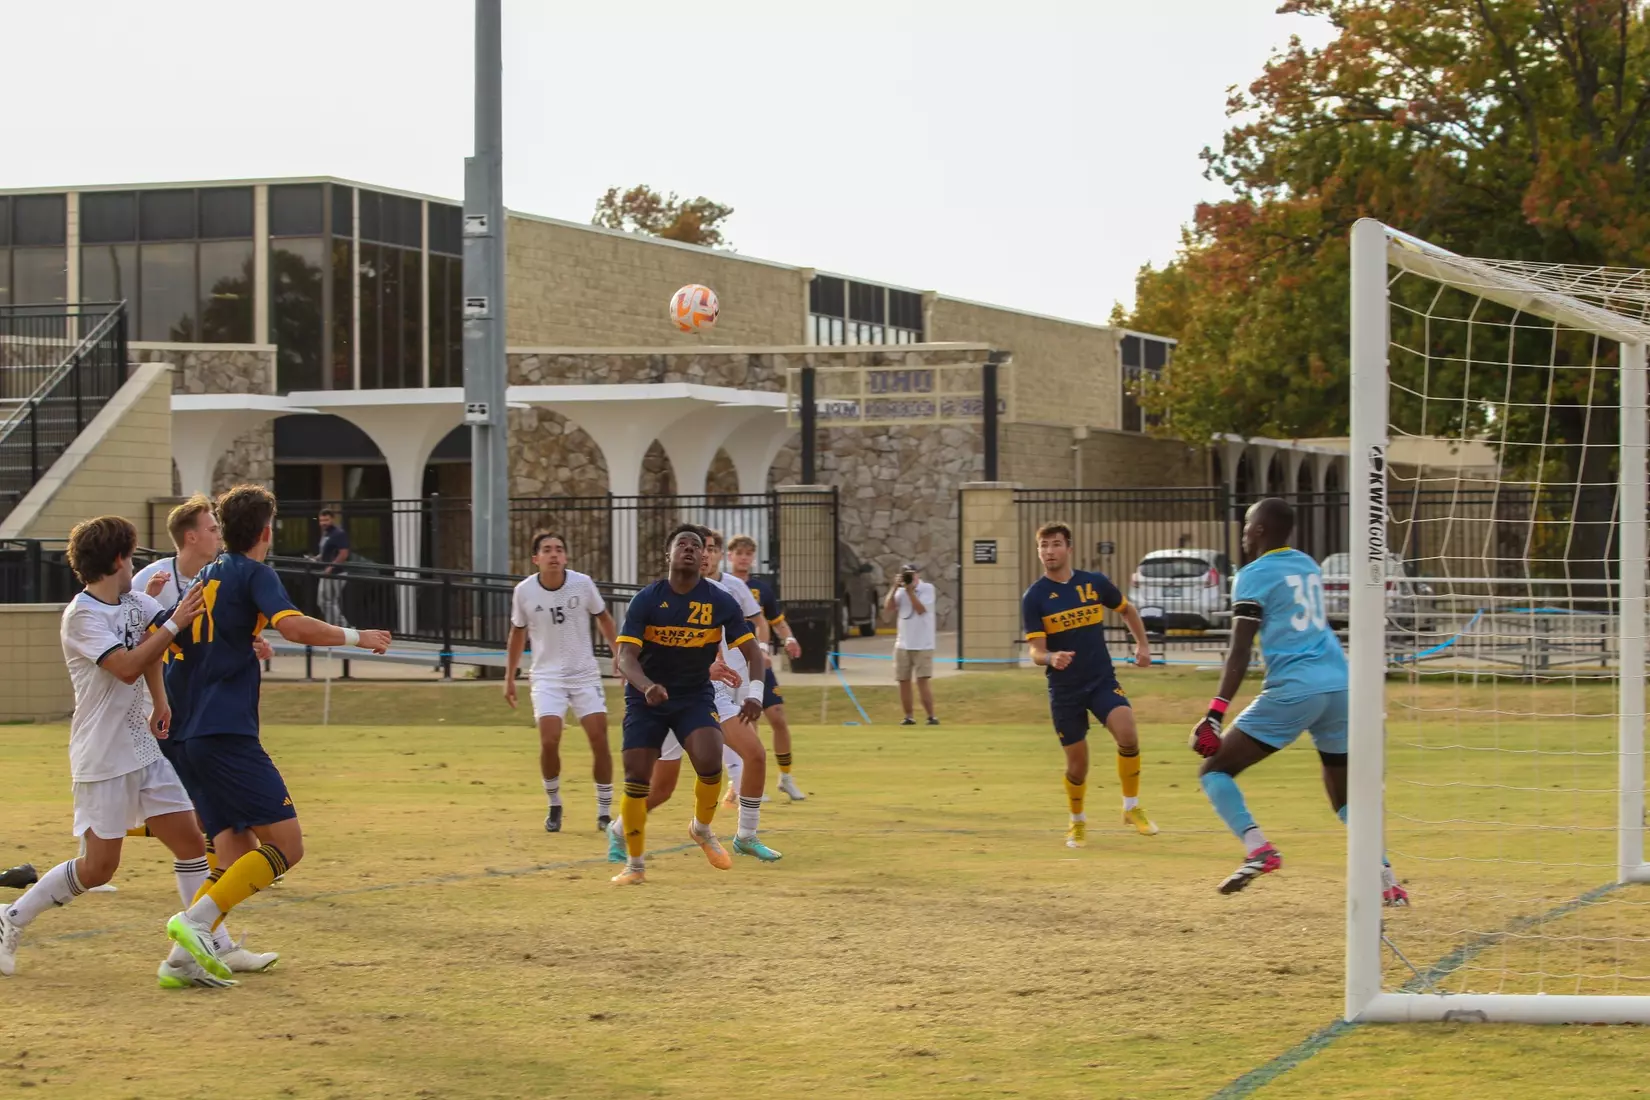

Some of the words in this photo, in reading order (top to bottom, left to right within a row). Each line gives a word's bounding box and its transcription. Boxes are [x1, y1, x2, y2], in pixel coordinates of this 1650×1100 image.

[1076, 583, 1099, 603] 14
[1285, 573, 1326, 632] 30
[549, 607, 565, 625] 15
[687, 601, 713, 625] 28
[1051, 607, 1099, 623] KANSAS
[1063, 616, 1092, 628] CITY
[653, 629, 705, 638] KANSAS
[660, 636, 694, 644] CITY
